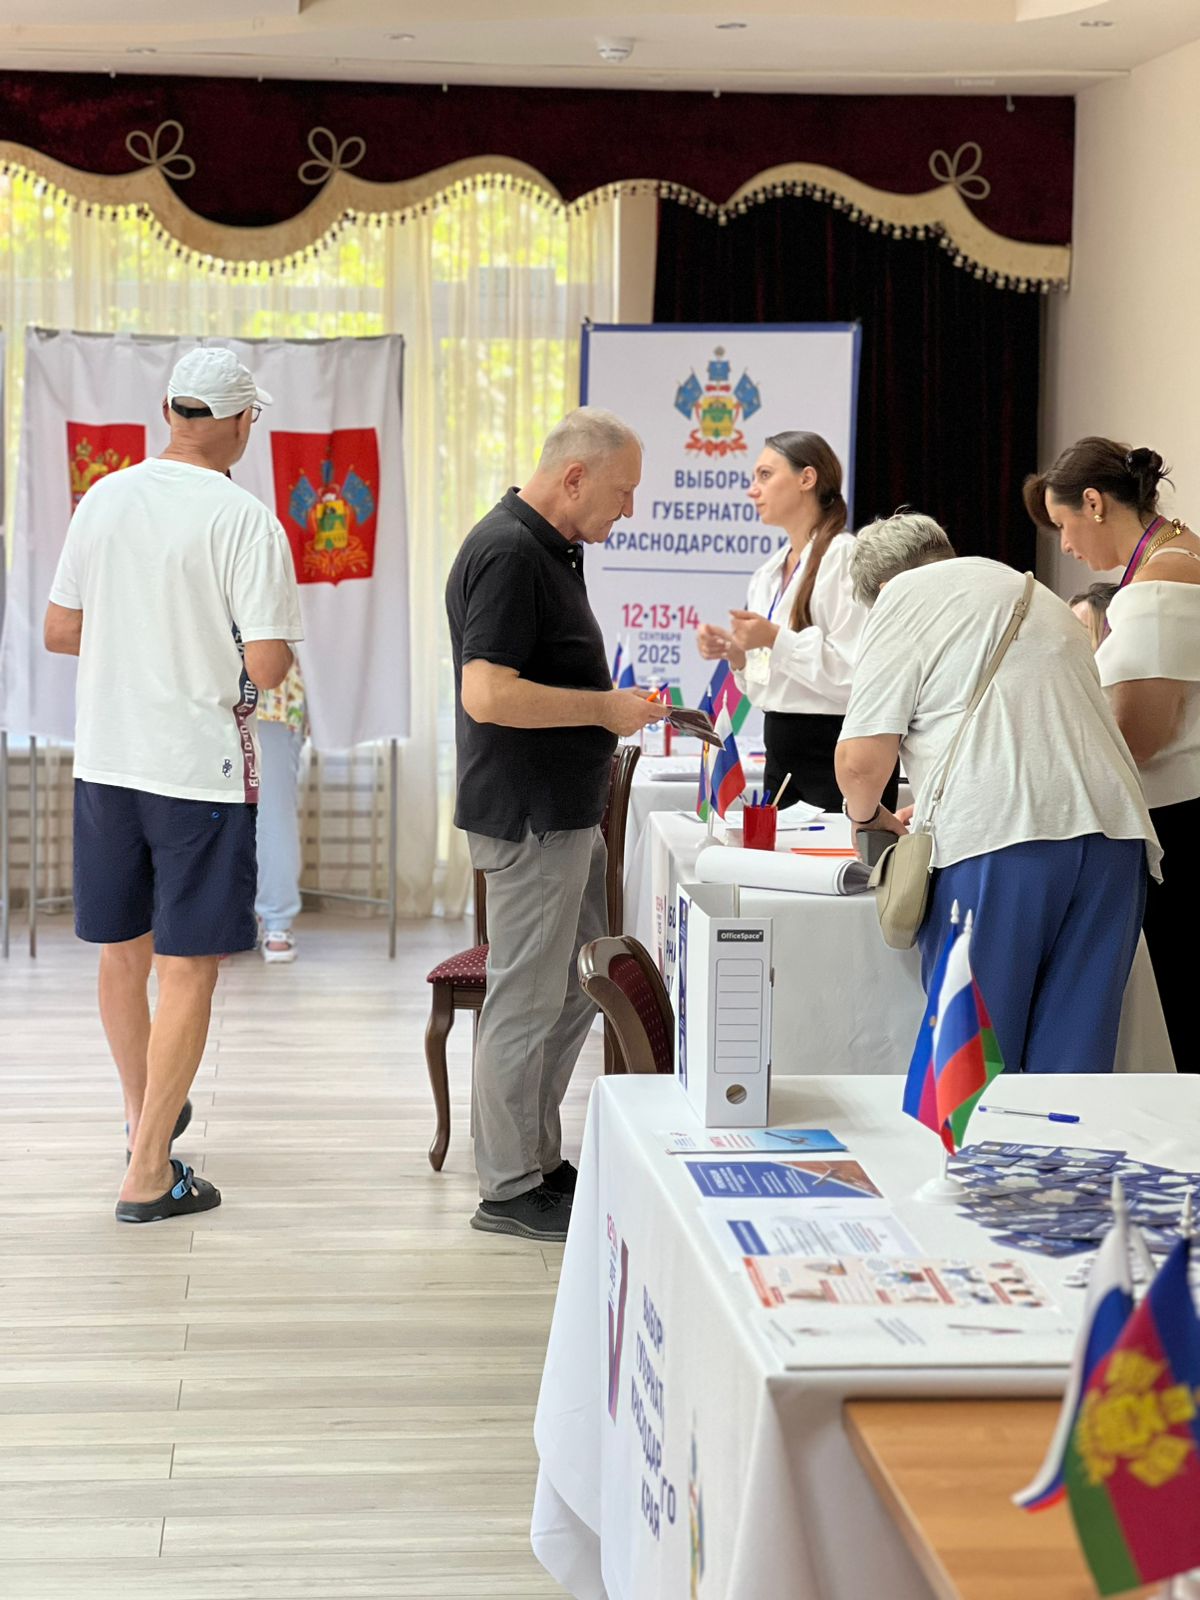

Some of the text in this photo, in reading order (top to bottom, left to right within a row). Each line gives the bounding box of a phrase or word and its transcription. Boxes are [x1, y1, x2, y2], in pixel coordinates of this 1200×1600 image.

[653, 501, 760, 522] ГУБЕРНАТО
[604, 532, 772, 555] КРАСНОДАРСКОГО
[638, 644, 681, 665] 2025
